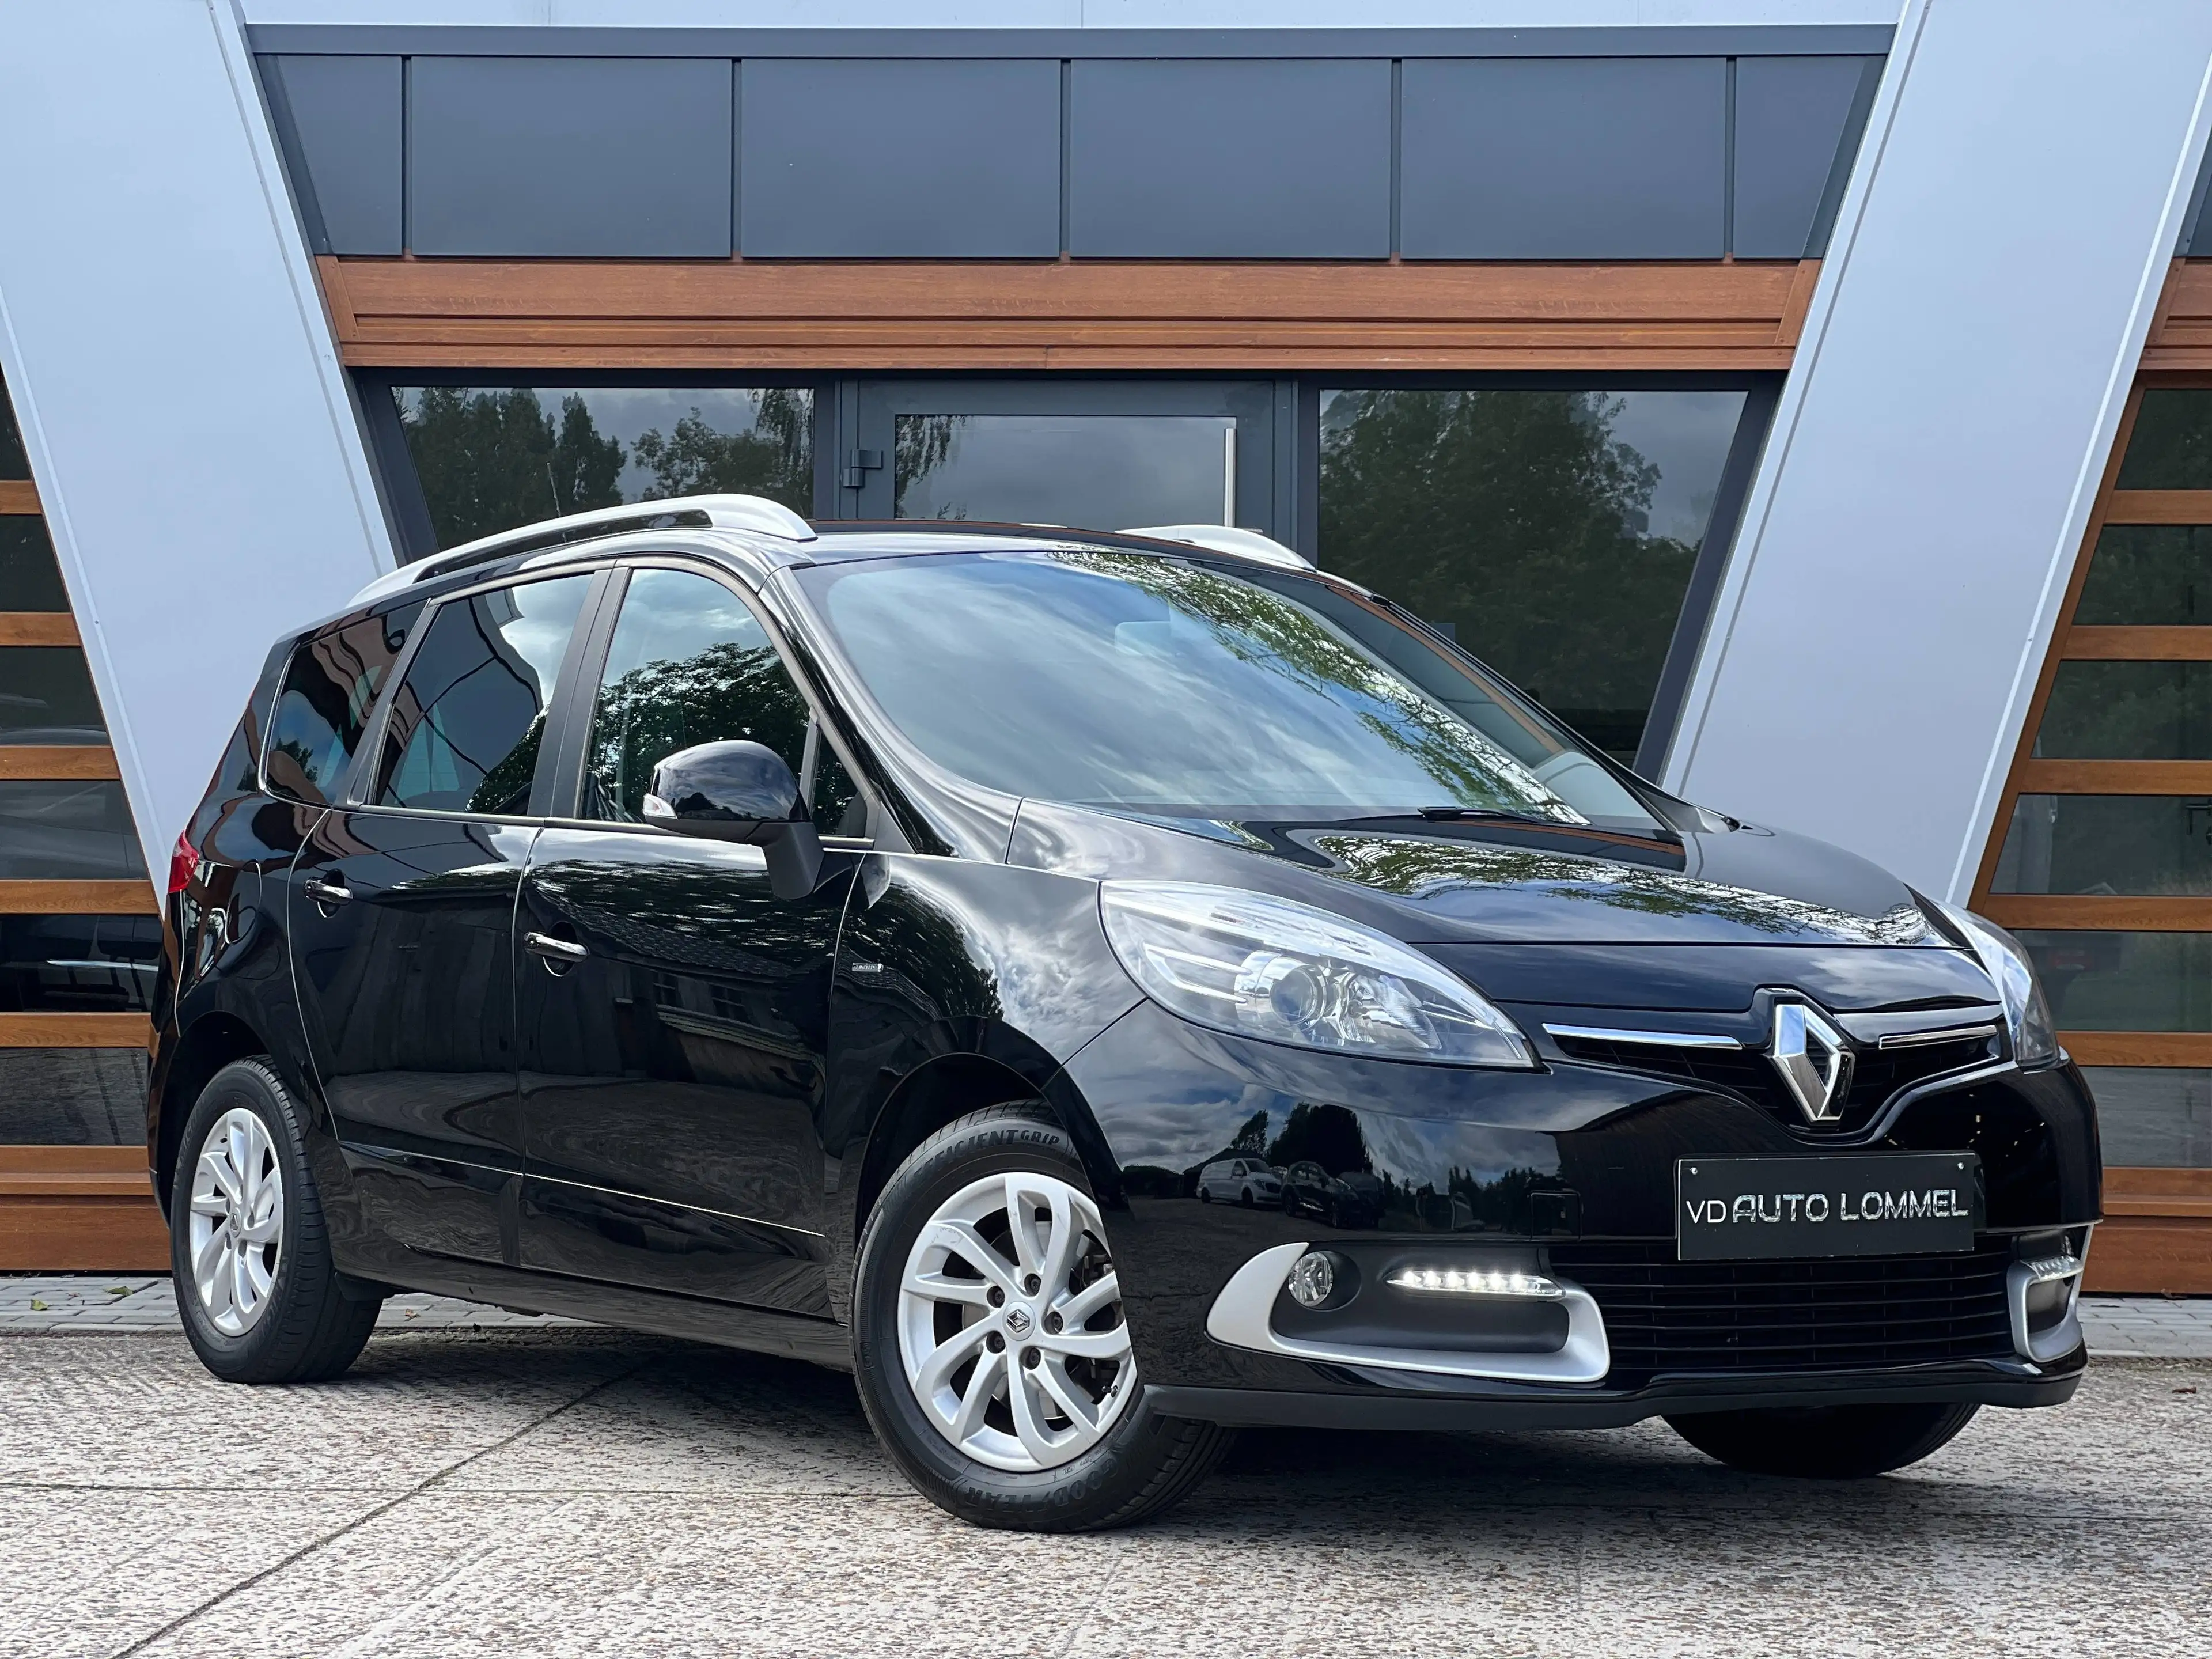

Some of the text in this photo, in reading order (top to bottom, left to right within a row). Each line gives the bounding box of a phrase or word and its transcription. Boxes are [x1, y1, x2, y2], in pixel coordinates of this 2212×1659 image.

[1021, 1130, 1060, 1145] GRIP
[1687, 1190, 1969, 1224] VD AUTO LOMMEL
